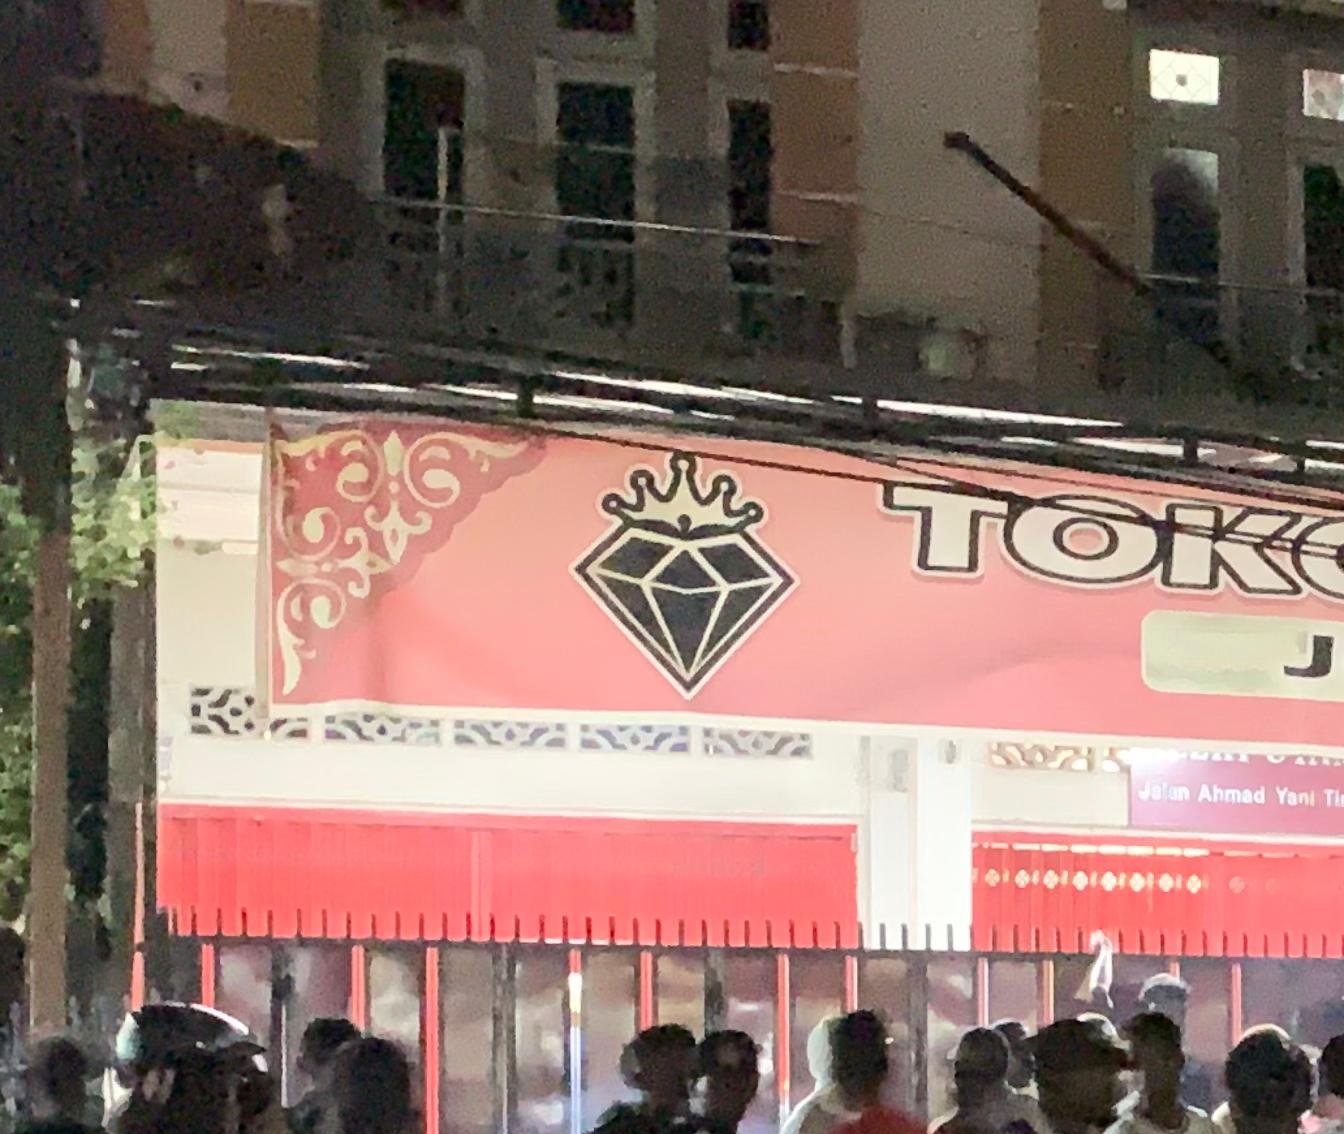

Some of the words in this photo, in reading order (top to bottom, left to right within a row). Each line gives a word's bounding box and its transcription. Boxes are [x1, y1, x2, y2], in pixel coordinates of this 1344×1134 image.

[1137, 781, 1190, 801] Jalan
[1197, 783, 1266, 805] Ahmad
[1275, 786, 1316, 807] Yani
